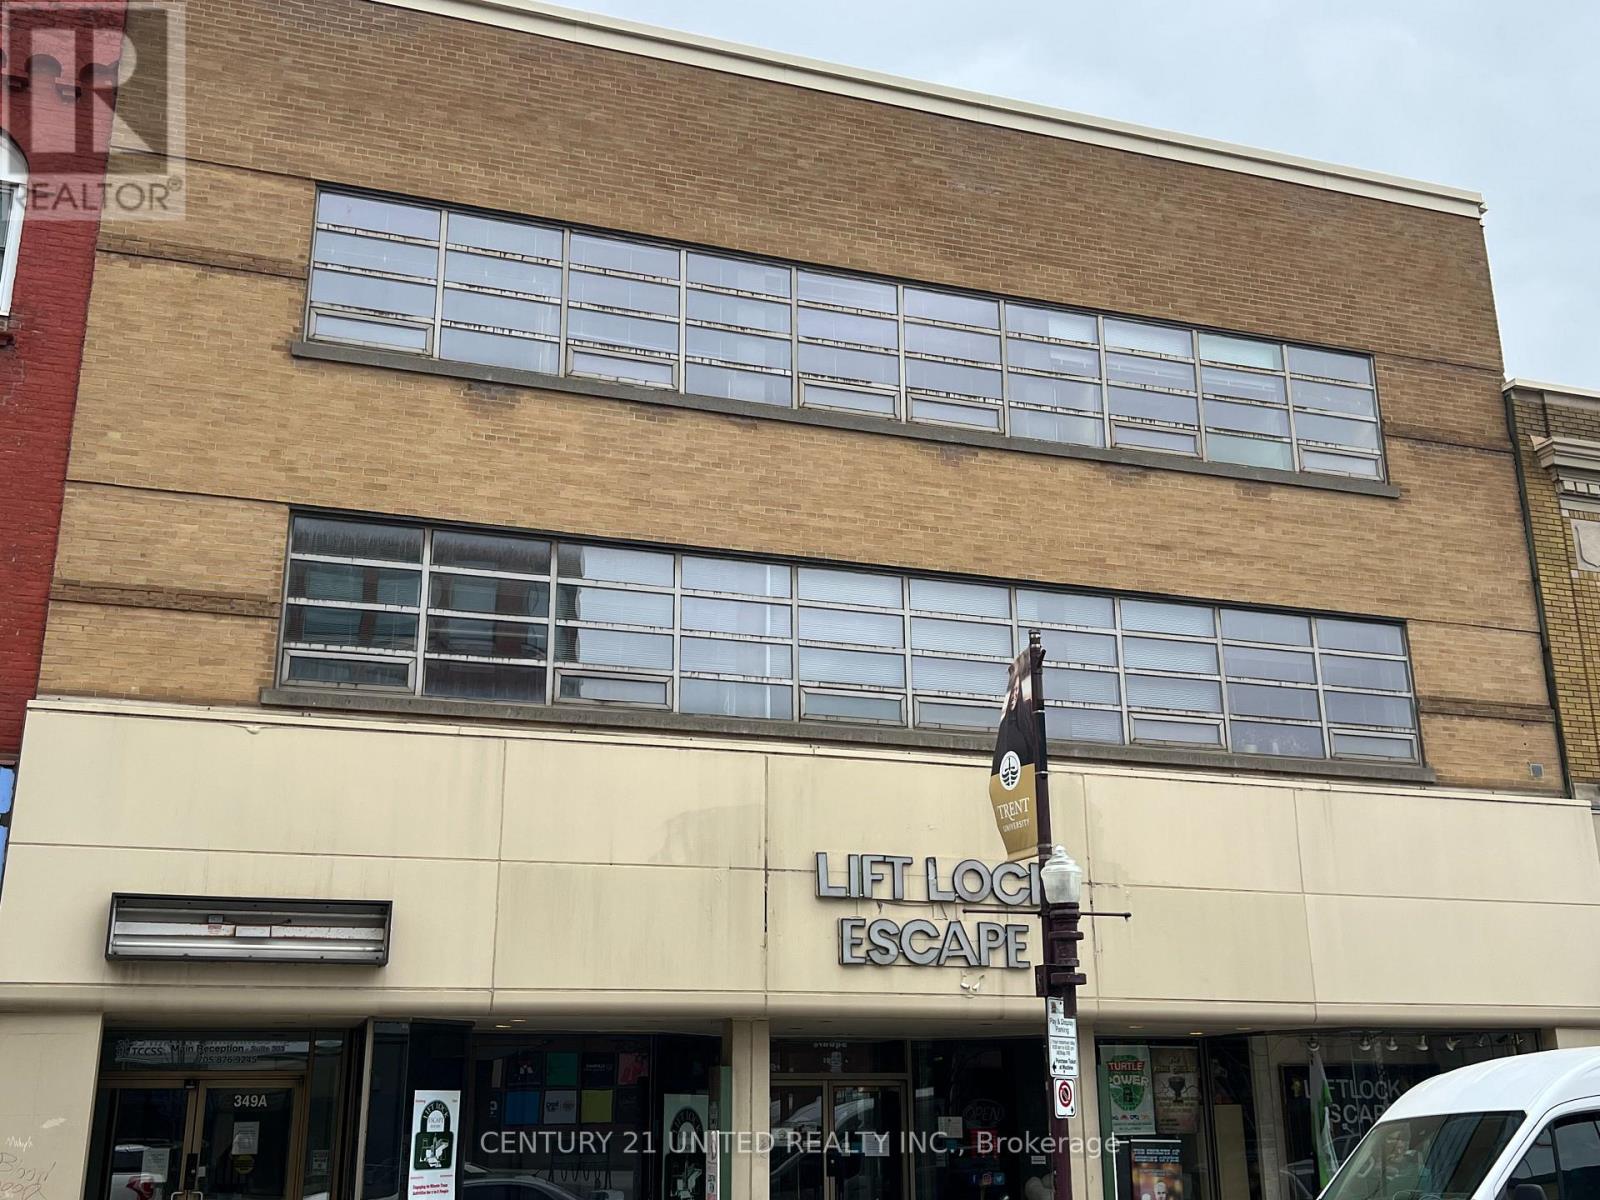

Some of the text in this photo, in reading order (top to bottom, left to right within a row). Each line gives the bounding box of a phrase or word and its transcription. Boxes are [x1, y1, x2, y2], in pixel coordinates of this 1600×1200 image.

[997, 797, 1030, 821] TRENT
[1002, 818, 1030, 832] UNIVERSITY
[815, 851, 913, 900] LIFT
[838, 917, 1031, 969] ESCAPE
[171, 1044, 194, 1054] Main
[197, 1044, 244, 1056] Reception
[1107, 1062, 1144, 1071] TURTLE
[1303, 1079, 1401, 1099] LFTLOCK
[234, 1094, 268, 1108] 349A
[1329, 1103, 1386, 1123] SCAP
